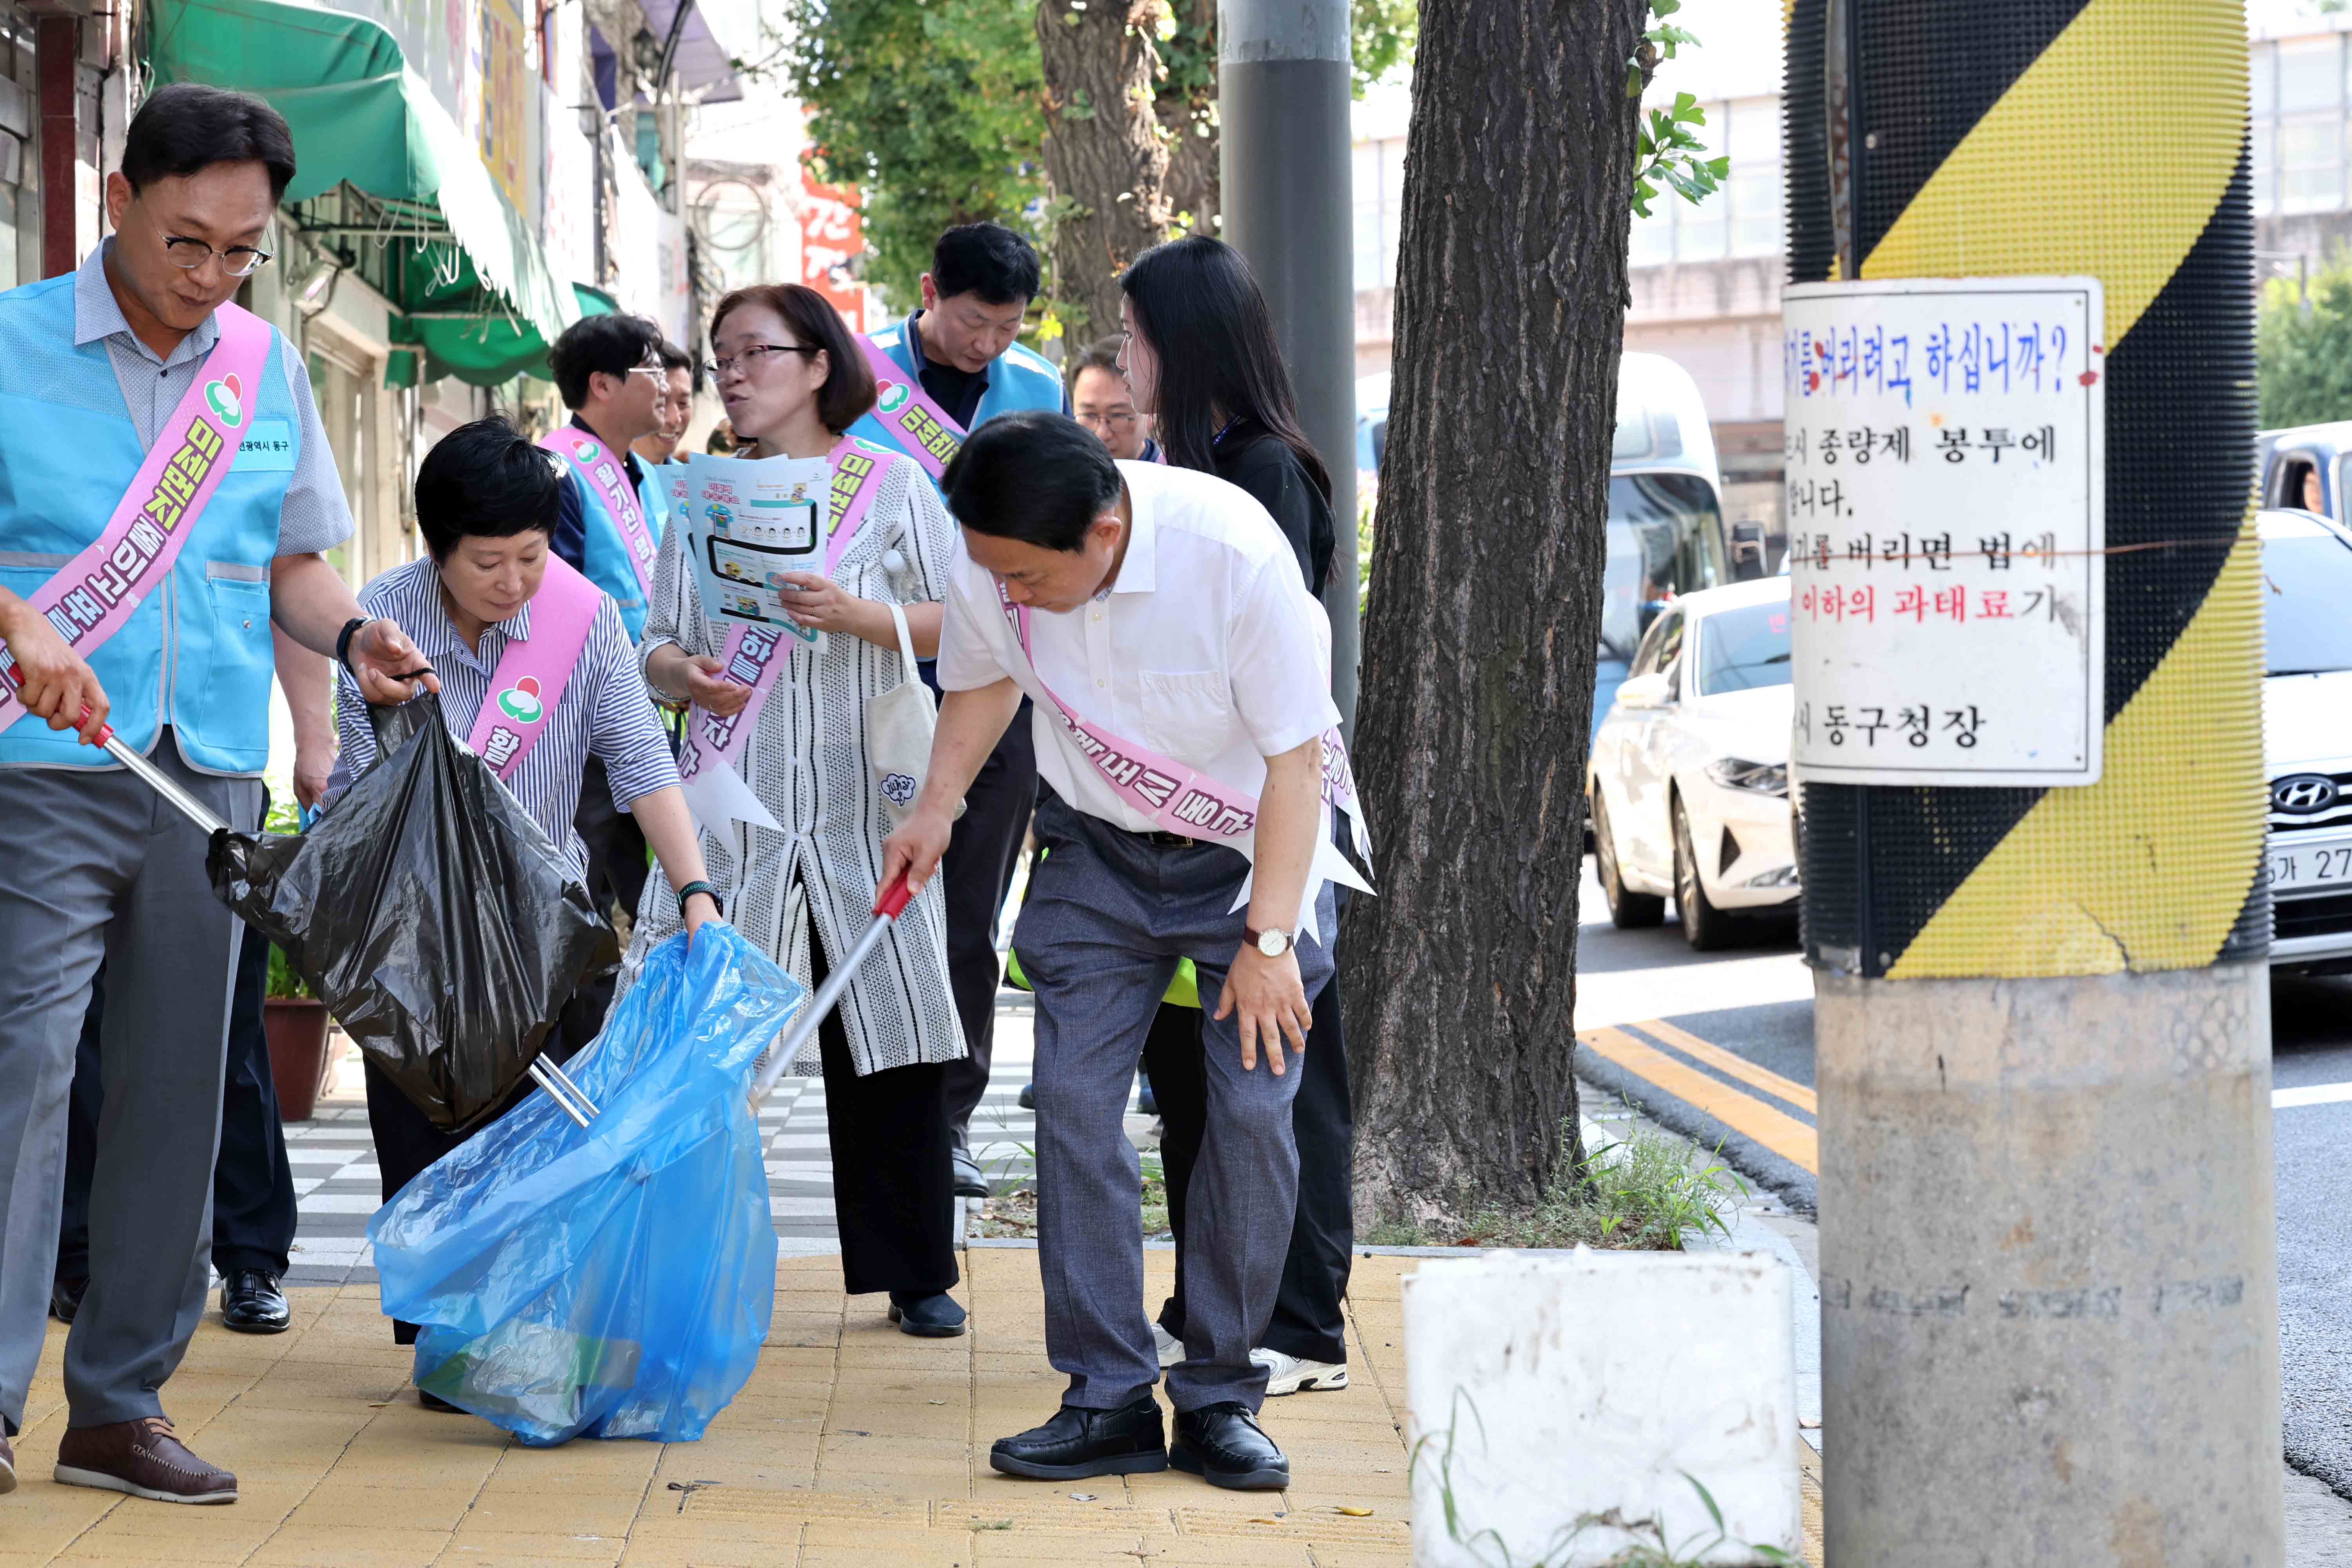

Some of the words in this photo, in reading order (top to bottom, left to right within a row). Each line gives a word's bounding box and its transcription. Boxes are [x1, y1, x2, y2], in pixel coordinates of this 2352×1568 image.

[1822, 325, 1910, 396] 버리려고
[1926, 322, 2065, 393] 하십니까?
[273, 441, 289, 452] 동구
[1819, 426, 1909, 465] 종량제
[1935, 425, 2054, 464] 봉투에
[145, 416, 223, 532] 미세먼지
[595, 462, 640, 534] 활기찬
[89, 516, 165, 603] 줄이고
[1847, 532, 1951, 570] 버리면
[1980, 532, 2054, 570] 법에
[1802, 584, 1875, 623] 이하의
[1825, 704, 1987, 748] 동구청장
[483, 727, 521, 768] 활
